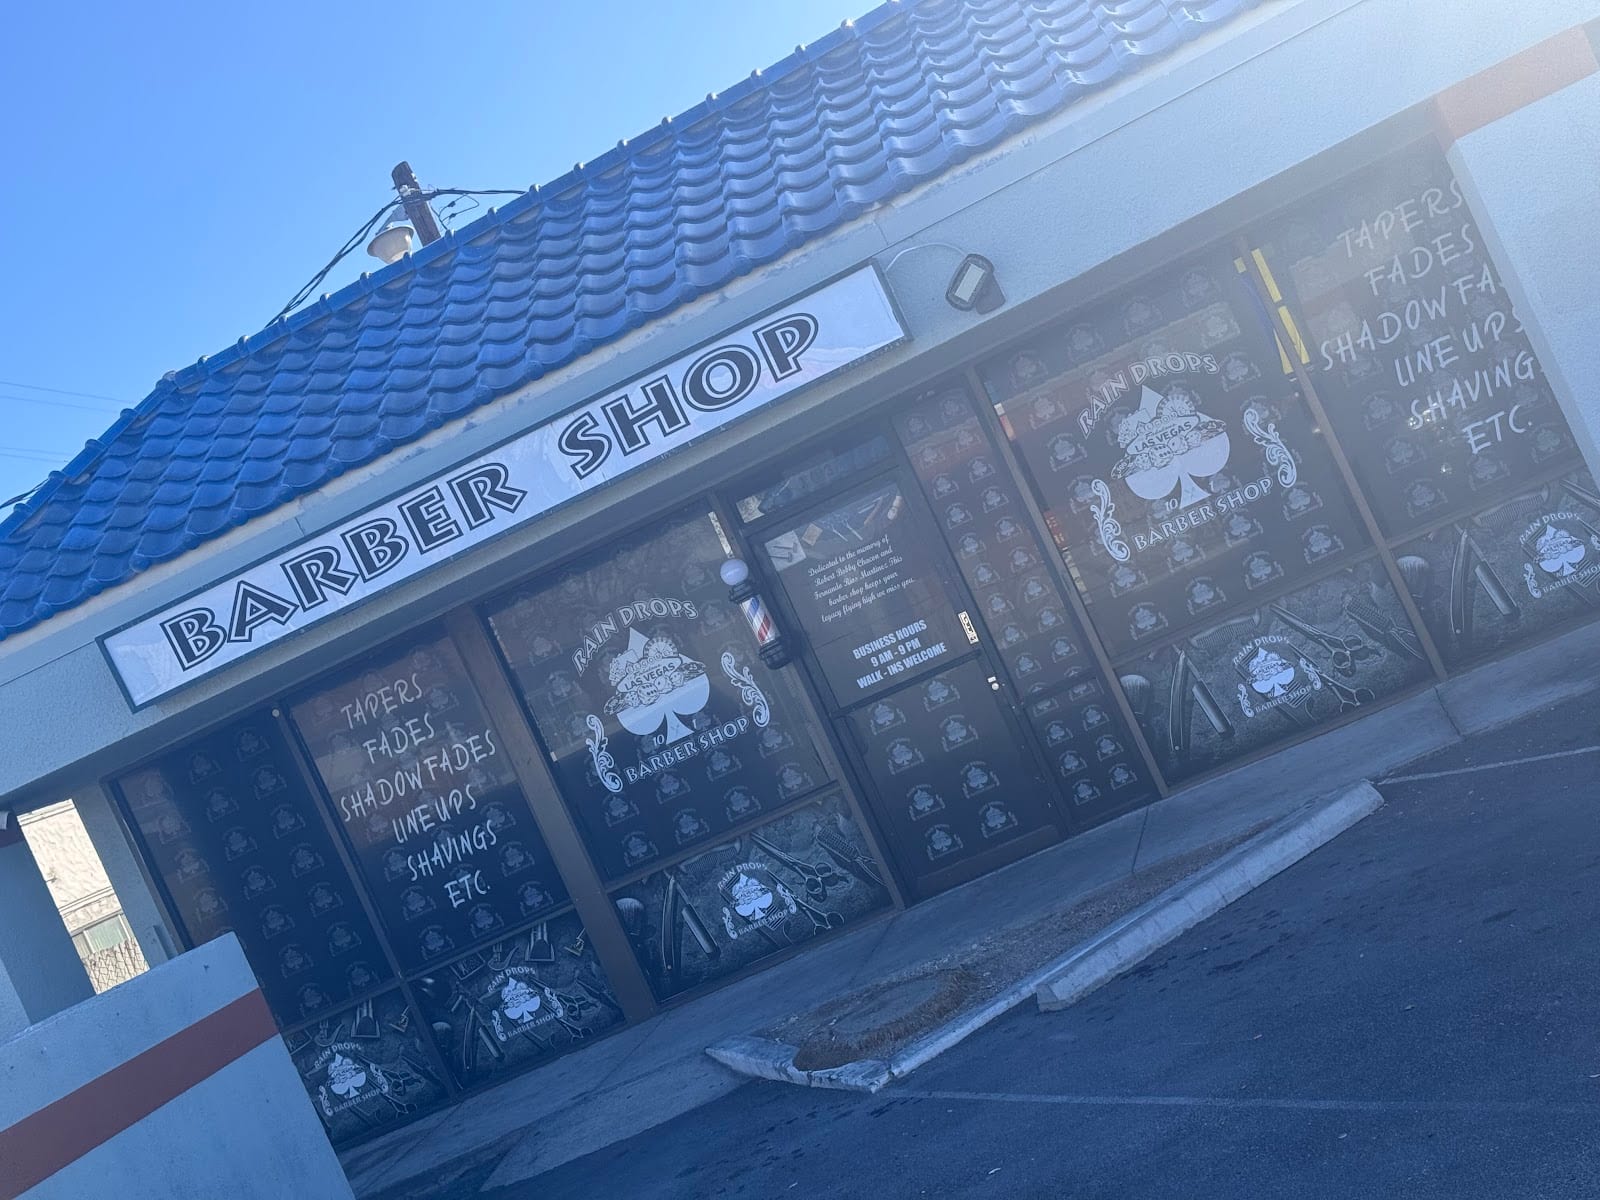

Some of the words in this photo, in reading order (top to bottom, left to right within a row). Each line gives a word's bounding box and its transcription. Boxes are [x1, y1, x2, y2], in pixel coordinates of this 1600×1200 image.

[1336, 177, 1463, 258] TAPERS
[1364, 223, 1474, 296] FADES
[1320, 286, 1446, 371] SHADOW
[1452, 263, 1504, 304] FA
[1394, 335, 1459, 387] LINE
[1076, 370, 1130, 440] RAIN
[1127, 352, 1221, 385] DROPS
[1408, 350, 1544, 430] SHAVING
[1135, 439, 1155, 452] LAS
[1156, 421, 1192, 442] VEGAS
[1462, 404, 1532, 454] ETC.
[160, 461, 527, 671] BARBER
[557, 312, 819, 479] SHOP
[1165, 498, 1178, 511] 10
[1132, 505, 1217, 552] BARBER
[1216, 477, 1273, 513] SHOP
[1520, 519, 1541, 544] RAIN
[1542, 512, 1581, 524] DROPS
[808, 556, 839, 577] Dedicated
[839, 555, 846, 563] to
[846, 551, 856, 560] the
[856, 541, 881, 554] memory
[881, 534, 889, 544] of
[814, 573, 835, 586] Robert
[836, 564, 857, 578] Bobby
[857, 554, 879, 567] Chacon
[880, 545, 893, 557] and
[814, 582, 843, 600] Fernando
[860, 563, 888, 580] Martinez
[889, 555, 903, 567] This
[829, 593, 849, 606] barber
[849, 587, 864, 598] shop
[865, 579, 882, 591] keeps
[883, 572, 898, 584] your
[1542, 574, 1577, 593] BARBER
[842, 602, 862, 615] flying
[862, 593, 876, 604] high
[876, 590, 886, 598] we
[886, 584, 901, 594] miss
[571, 613, 619, 677] RAIN
[616, 598, 699, 628] DROPS
[852, 633, 897, 660] BUSINESS
[895, 619, 927, 641] HOURS
[870, 656, 879, 668] 9
[879, 649, 894, 665] AM
[897, 644, 906, 655] 9
[905, 637, 921, 652] PM
[1233, 642, 1253, 666] RAIN
[1254, 635, 1290, 647] DROPS
[624, 677, 643, 691] LAS
[643, 663, 676, 682] VEGAS
[856, 669, 884, 689] WALK
[886, 661, 905, 676] INS
[903, 642, 947, 669] WELCOME
[341, 673, 423, 729] TAPERS
[1255, 696, 1289, 713] BARBER
[1288, 685, 1312, 701] SHOP
[362, 712, 435, 764] FADES
[624, 741, 700, 784] BARBER
[699, 716, 750, 751] SHOP
[653, 734, 664, 747] 10
[340, 762, 423, 822] SHADOW
[423, 729, 496, 781] FADES
[392, 804, 435, 843] LINE
[435, 784, 476, 822] UPS
[407, 819, 497, 881] SHAVINGS
[444, 870, 490, 908] ETC.
[718, 868, 735, 890] RAIN
[736, 862, 768, 873] DROPS
[739, 919, 767, 935] BARBER
[766, 909, 788, 922] SHOP
[488, 971, 505, 993] RAIN
[505, 966, 536, 977] DROPS
[507, 1021, 536, 1037] BARBER
[536, 1013, 555, 1026] SHOP
[314, 1048, 331, 1070] RAIN
[331, 1042, 362, 1053] DROPS
[334, 1097, 361, 1113] BARBER
[361, 1088, 380, 1102] SHOP
